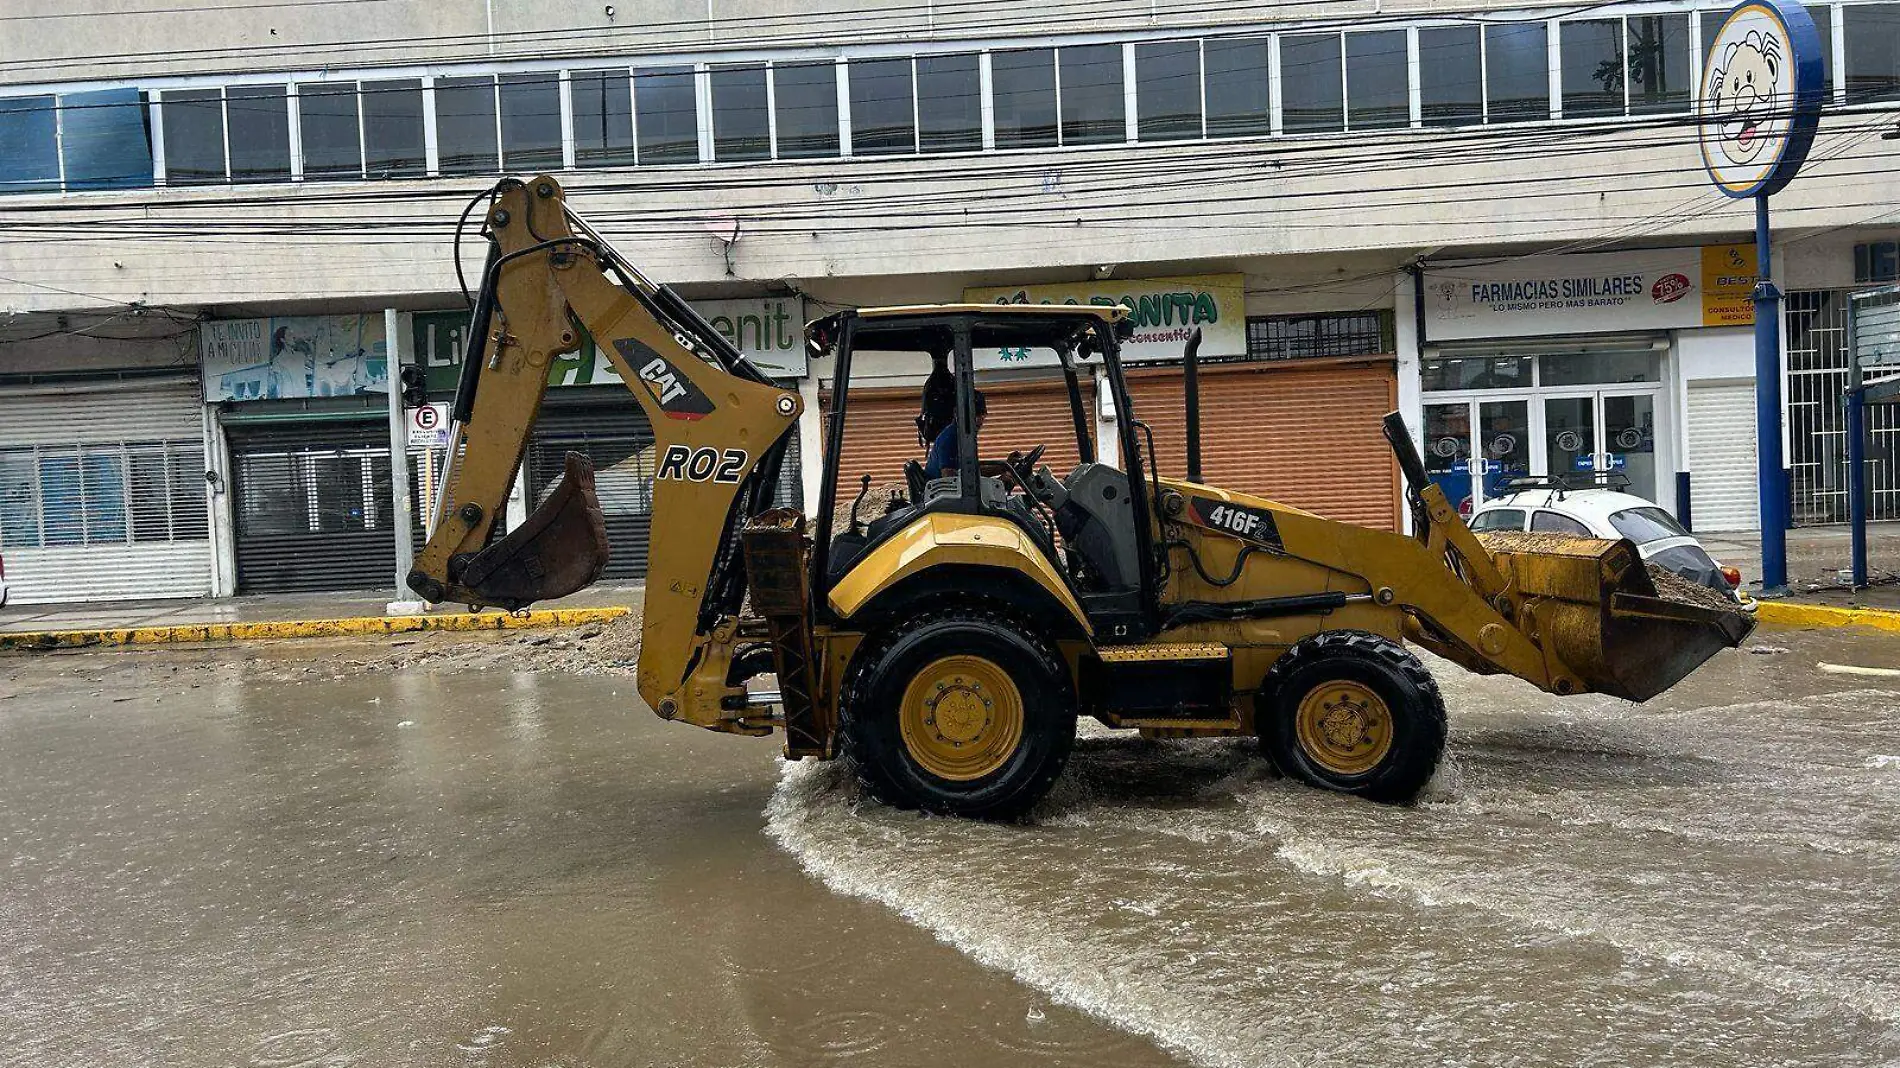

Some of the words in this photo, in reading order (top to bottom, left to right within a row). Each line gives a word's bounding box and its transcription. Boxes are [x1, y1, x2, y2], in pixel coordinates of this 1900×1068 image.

[1472, 280, 1559, 302] FARMACIAS
[1562, 275, 1643, 299] SIMILARES
[1656, 278, 1684, 297] 75%
[1507, 301, 1537, 311] MISMO
[1538, 300, 1564, 310] PERO
[1565, 299, 1585, 308] MAS
[708, 302, 793, 351] enit
[1128, 327, 1192, 345] consentid
[639, 357, 686, 405] CAT
[422, 411, 433, 424] E
